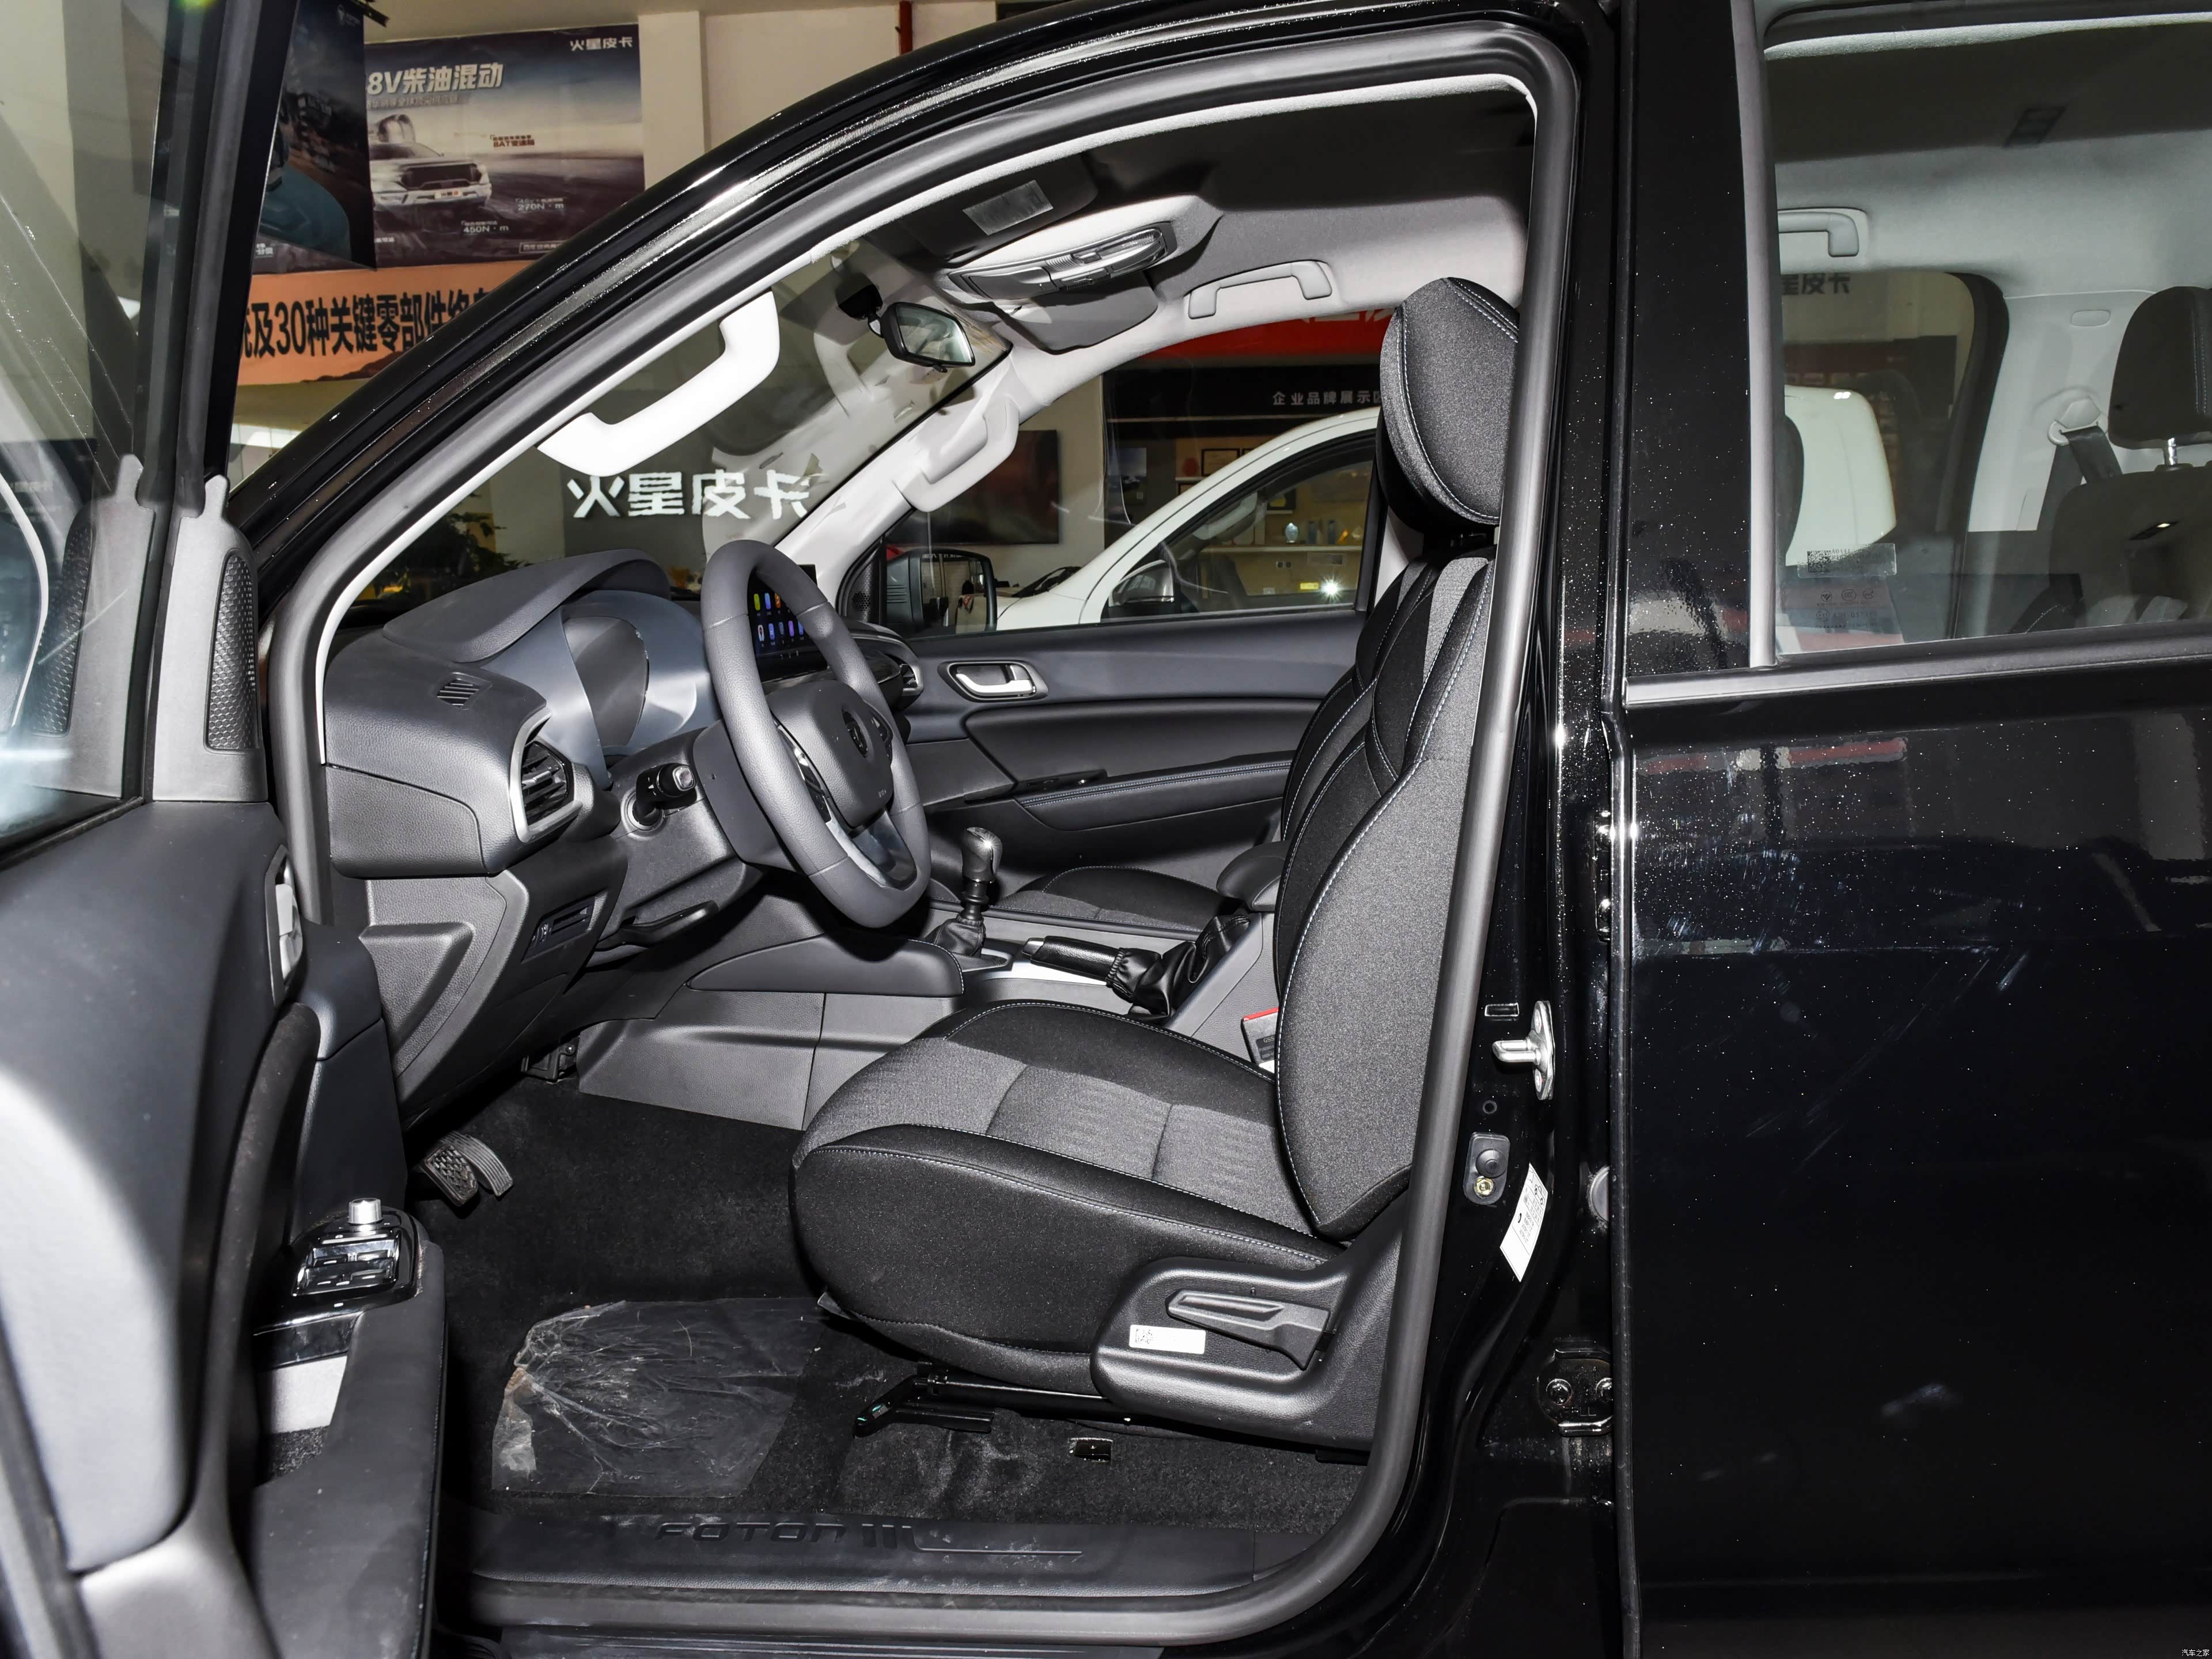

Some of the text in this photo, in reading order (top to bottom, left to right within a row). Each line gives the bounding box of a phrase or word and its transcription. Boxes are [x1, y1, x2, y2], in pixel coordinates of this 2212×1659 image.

[570, 37, 632, 51] 火星皮卡
[367, 62, 504, 95] 8V柴油混动
[243, 287, 490, 358] 及30种关键零部件
[567, 469, 810, 519] 火星皮卡
